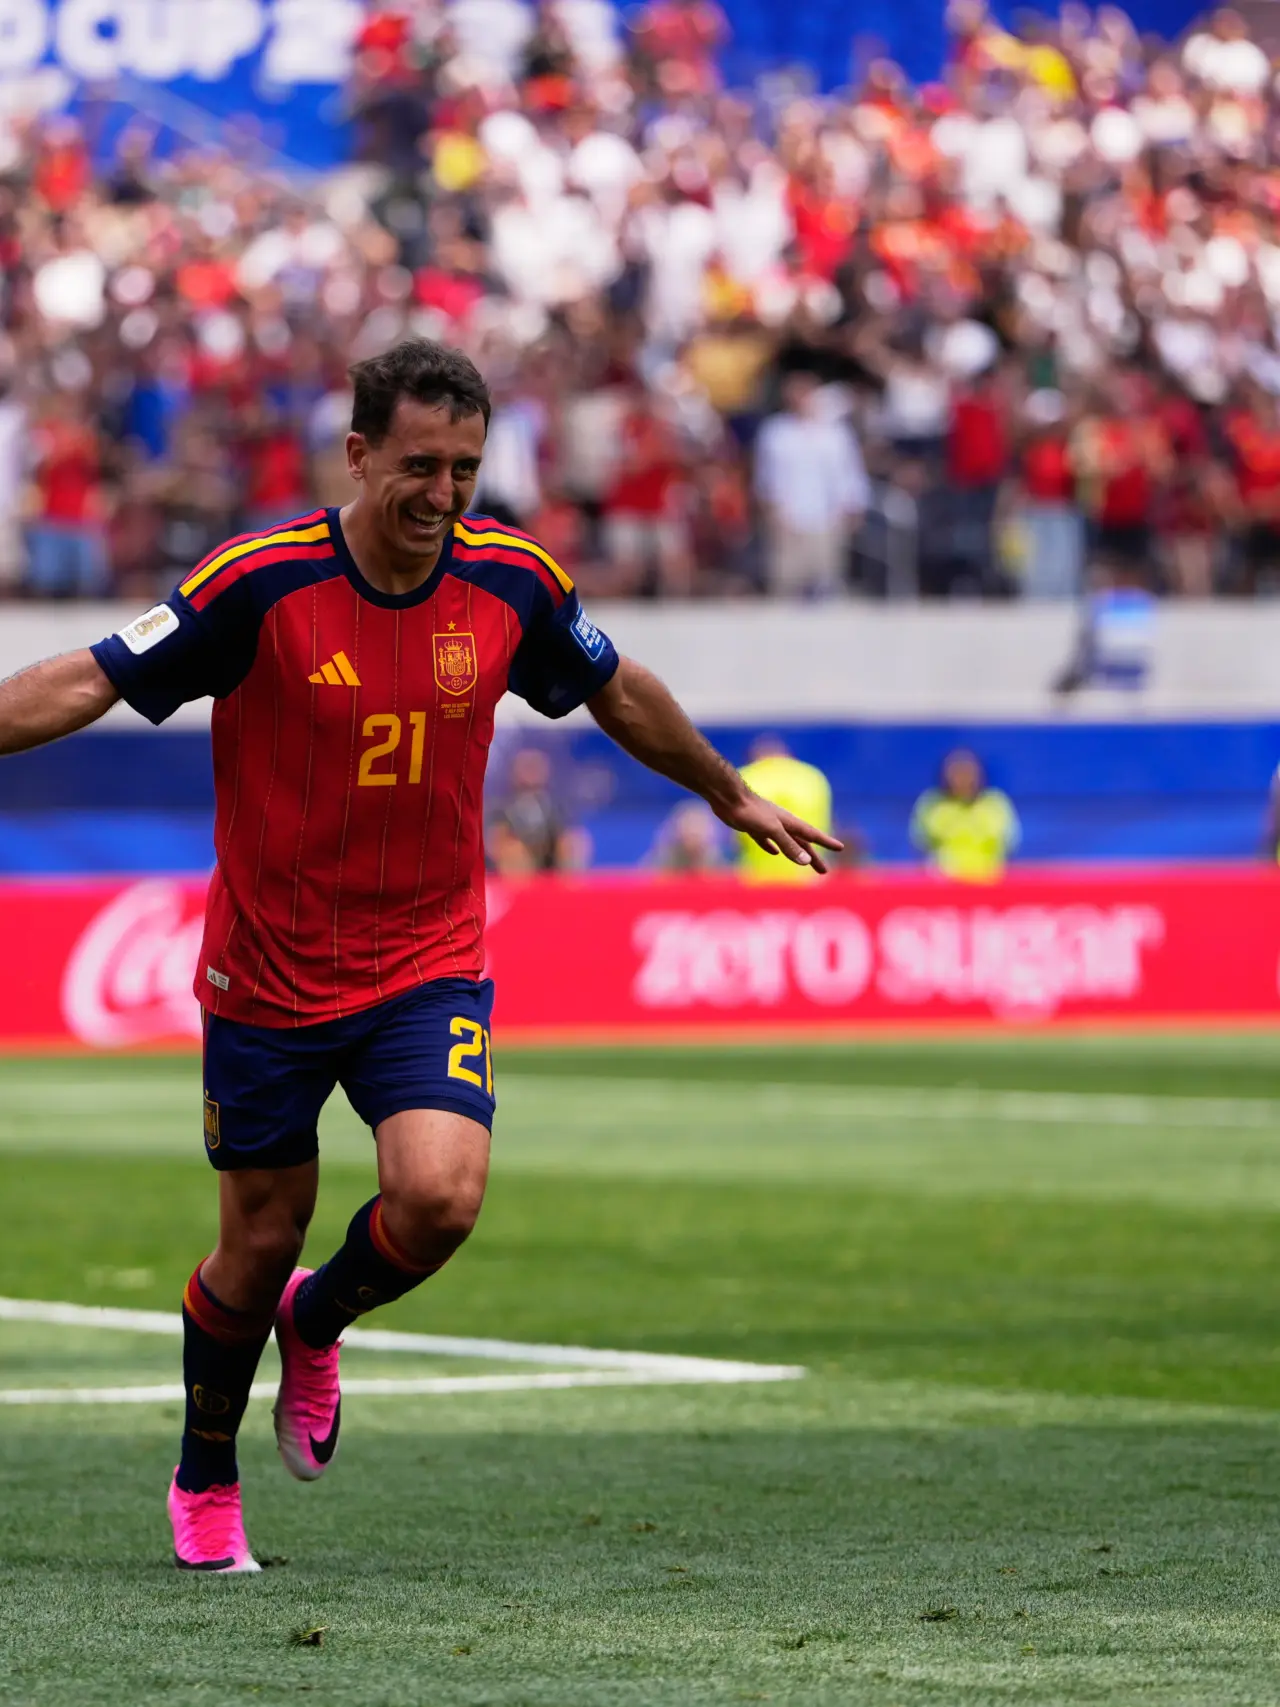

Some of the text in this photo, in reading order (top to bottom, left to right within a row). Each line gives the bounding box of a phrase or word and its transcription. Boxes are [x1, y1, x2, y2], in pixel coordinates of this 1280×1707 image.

[358, 711, 426, 786] 21
[632, 902, 1167, 1024] zero sugar
[448, 1016, 492, 1097] 21
